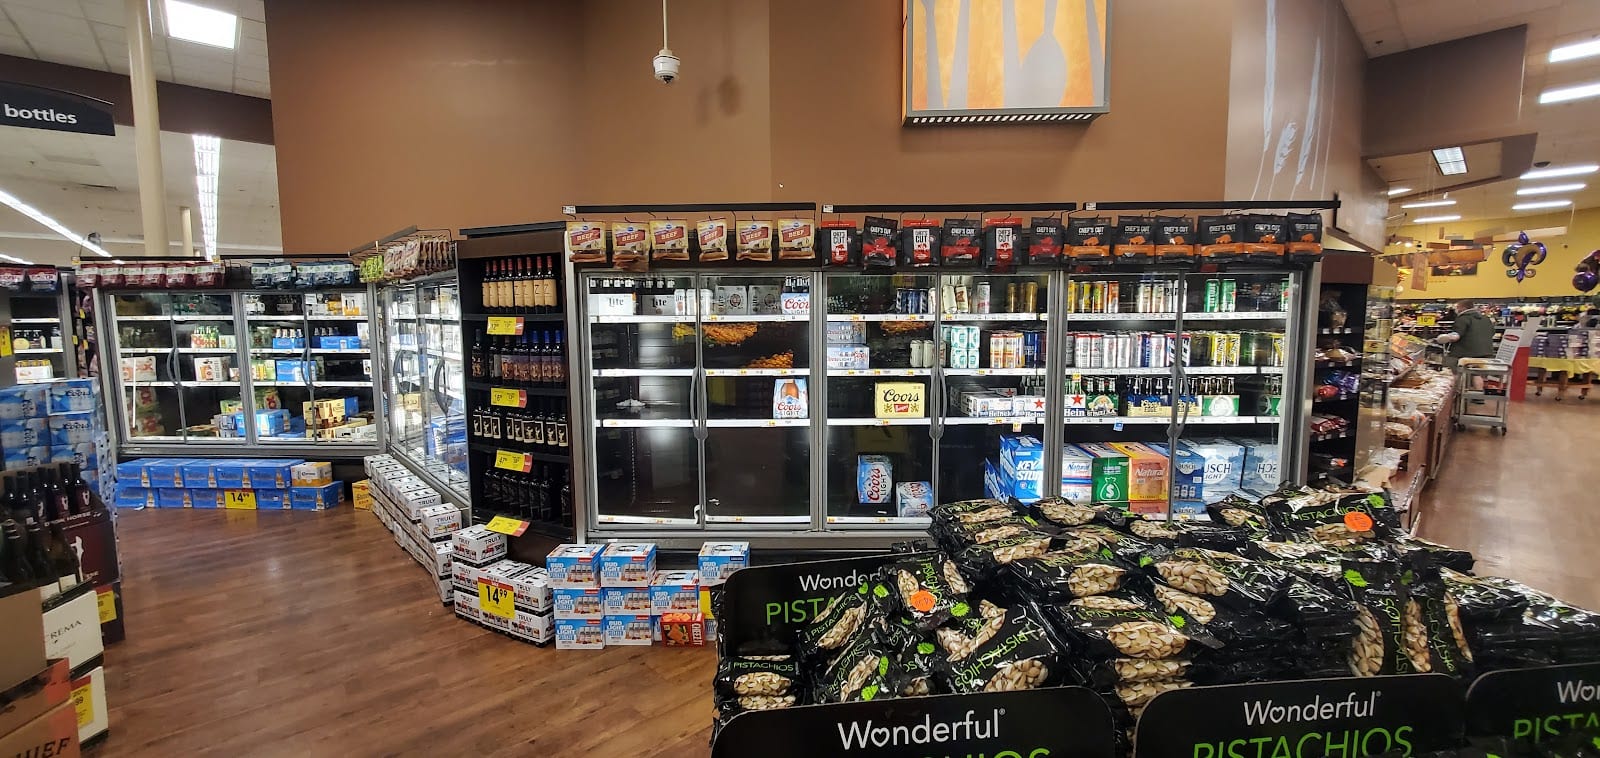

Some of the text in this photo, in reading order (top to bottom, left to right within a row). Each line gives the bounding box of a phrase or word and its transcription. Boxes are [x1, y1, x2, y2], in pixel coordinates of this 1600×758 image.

[4, 103, 78, 125] bottles
[661, 231, 678, 240] BEEF
[883, 389, 920, 402] Coors
[777, 402, 802, 412] Coors
[1064, 408, 1085, 417] Hein
[1015, 460, 1037, 471] KEY
[1135, 467, 1165, 477] Natural
[865, 468, 881, 501] Coors
[437, 514, 455, 523] TRULY
[485, 535, 501, 545] TRULY
[799, 566, 883, 592] Wonder
[765, 596, 837, 626] PISTA
[811, 594, 857, 636] PISTACHIOS
[518, 614, 533, 623] TRULY
[1383, 597, 1409, 675] ISTACHIOS
[733, 660, 794, 673] PISTACHIOS
[1243, 691, 1377, 726] Wonderful
[837, 708, 999, 751] Wonderful
